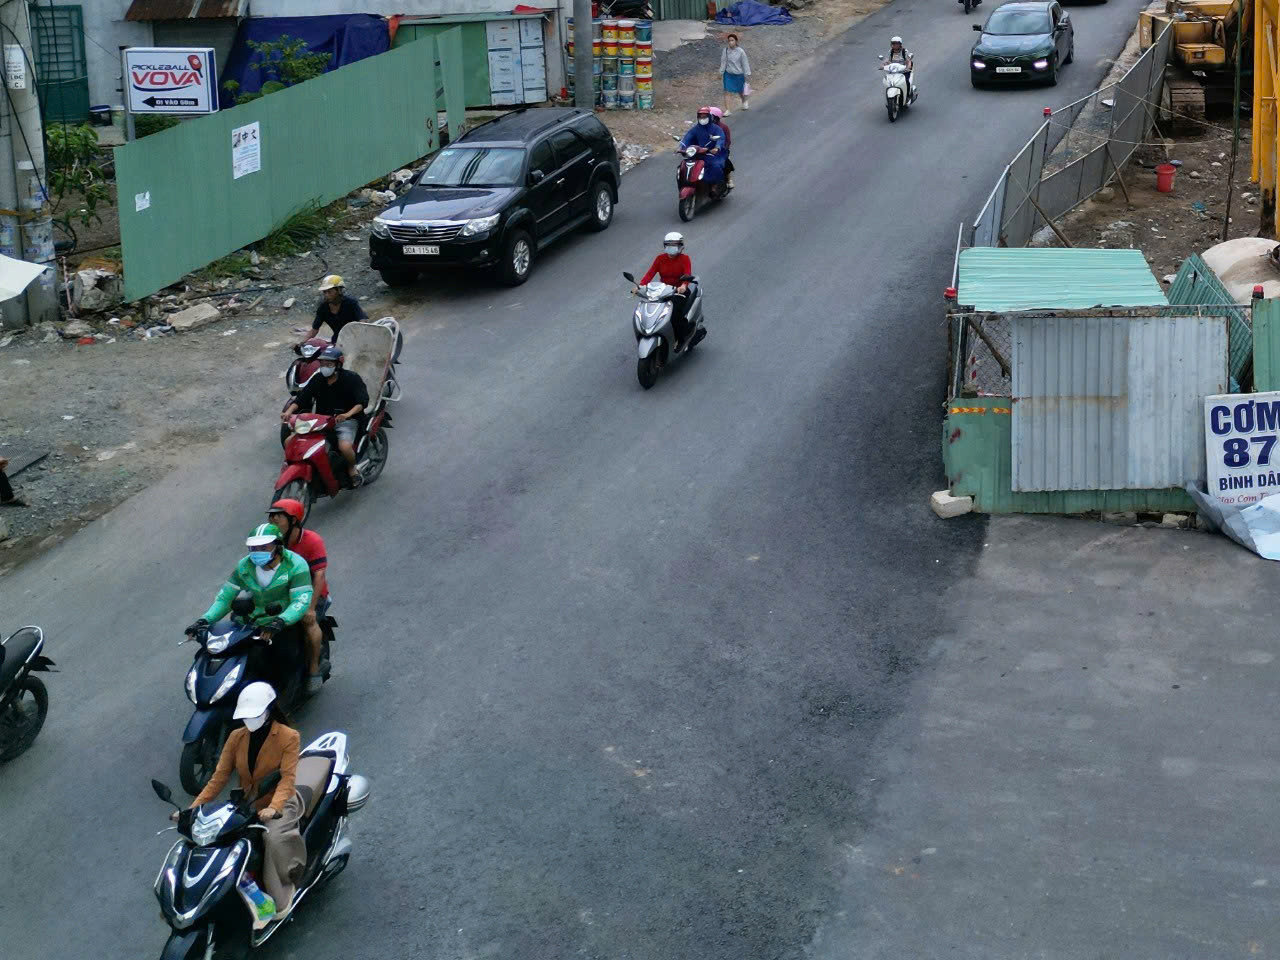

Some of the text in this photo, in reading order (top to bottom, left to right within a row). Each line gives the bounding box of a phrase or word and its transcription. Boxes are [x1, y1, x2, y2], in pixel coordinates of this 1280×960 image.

[132, 71, 202, 86] VOVA
[1223, 435, 1277, 468] 87
[1219, 474, 1253, 491] BÌNH
